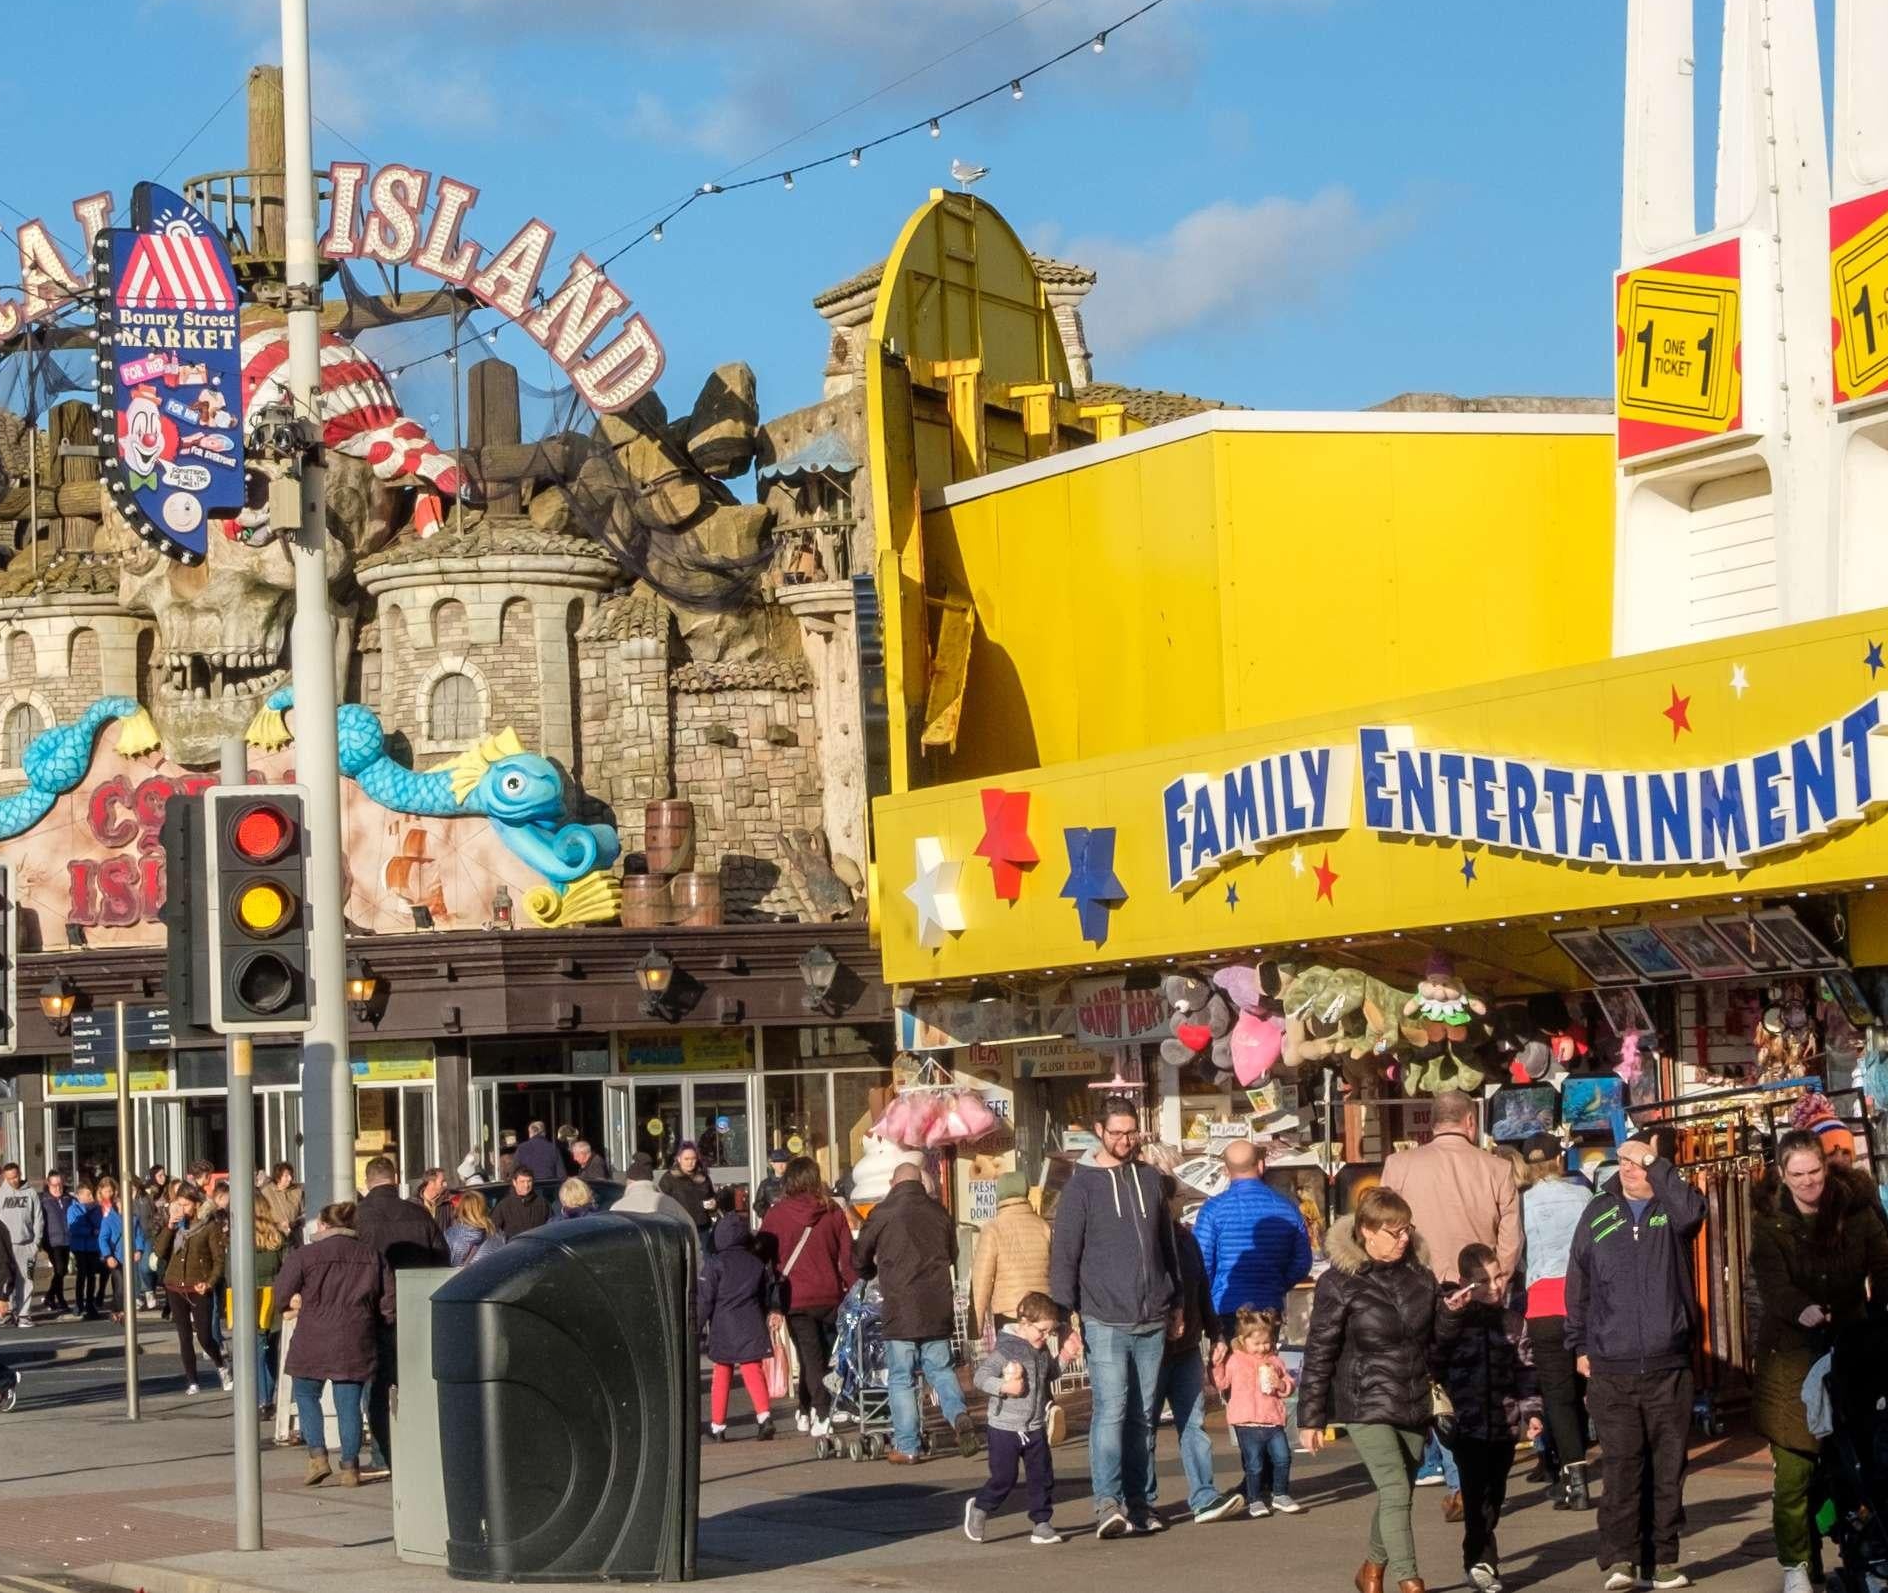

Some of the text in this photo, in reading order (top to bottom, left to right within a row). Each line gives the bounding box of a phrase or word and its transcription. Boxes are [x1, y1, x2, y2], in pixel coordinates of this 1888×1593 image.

[321, 161, 667, 413] ISLAND
[120, 309, 236, 328] Bonny Street
[121, 327, 236, 349] MARKET
[1663, 338, 1686, 357] ONE
[123, 364, 144, 381] FOR
[1654, 358, 1692, 379] TICKET
[168, 400, 184, 416] FOR
[1164, 697, 1887, 893] FAMILY ENTERTAINMENT
[969, 1182, 997, 1194] FRESH
[3, 1197, 28, 1208] NIKE
